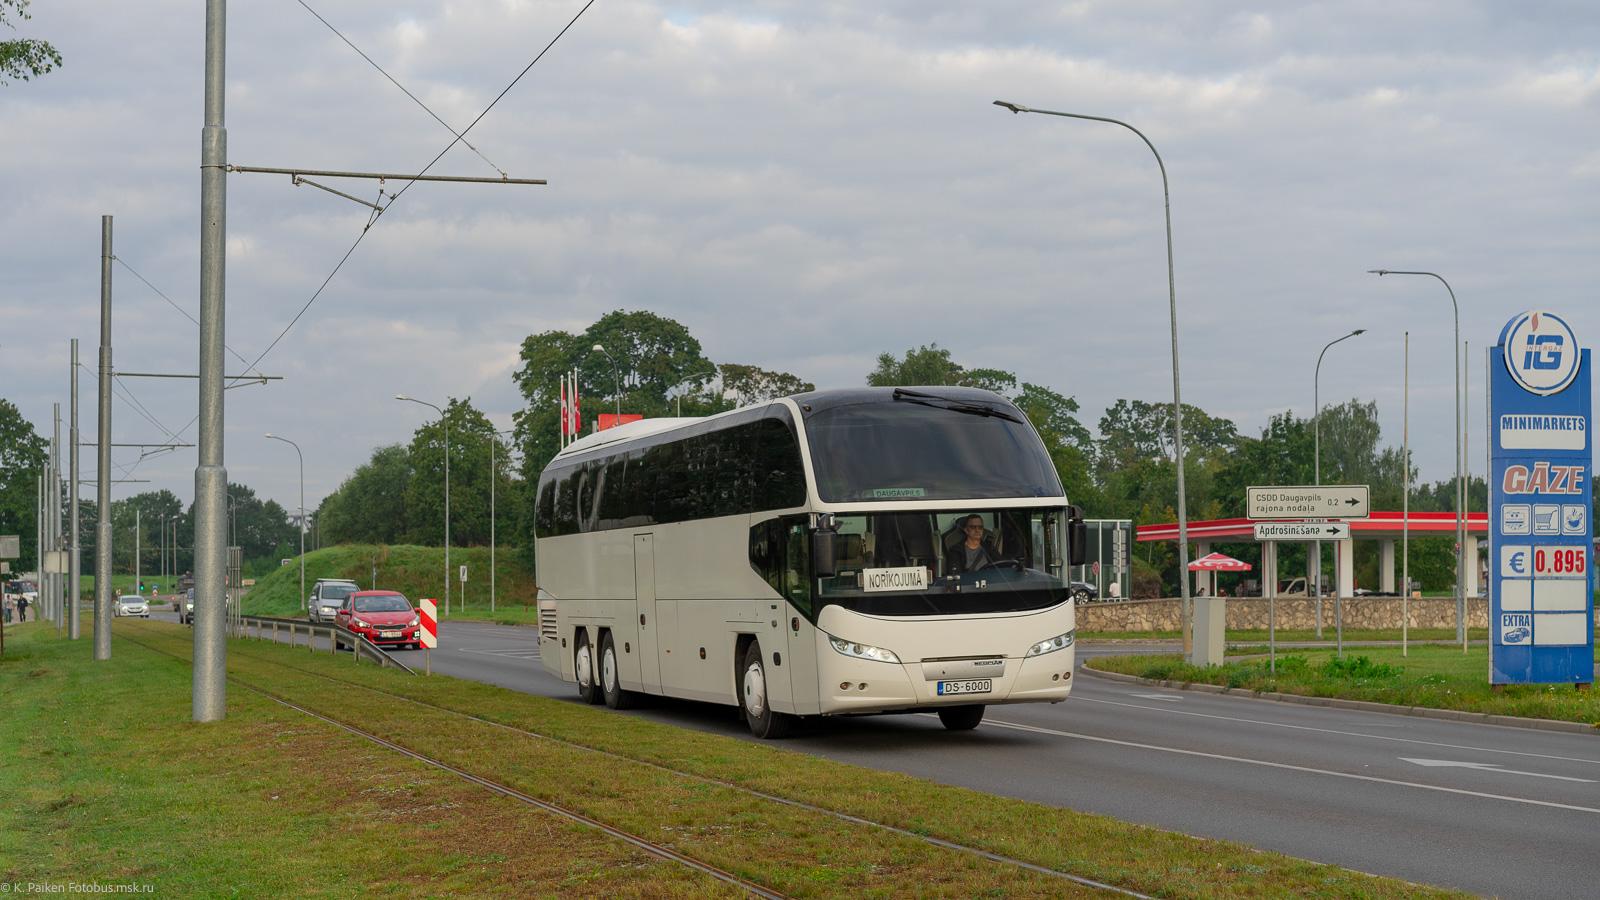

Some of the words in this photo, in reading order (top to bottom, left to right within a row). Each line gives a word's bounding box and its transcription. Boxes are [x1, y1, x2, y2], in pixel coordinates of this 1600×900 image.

[1502, 416, 1585, 431] MINIMARKETS
[1502, 461, 1585, 495] GĀZE
[1256, 494, 1278, 502] CSDD
[1280, 493, 1322, 503] Daugavpils
[1327, 499, 1339, 507] 0.2
[1256, 505, 1284, 513] rajona
[1286, 504, 1315, 513] nodaļa
[1509, 552, 1525, 574] €
[1535, 549, 1585, 573] 0.895
[869, 569, 922, 588] NORĪKOJUMĀ
[1503, 615, 1530, 627] EXTRA
[945, 681, 989, 693] DS-6000
